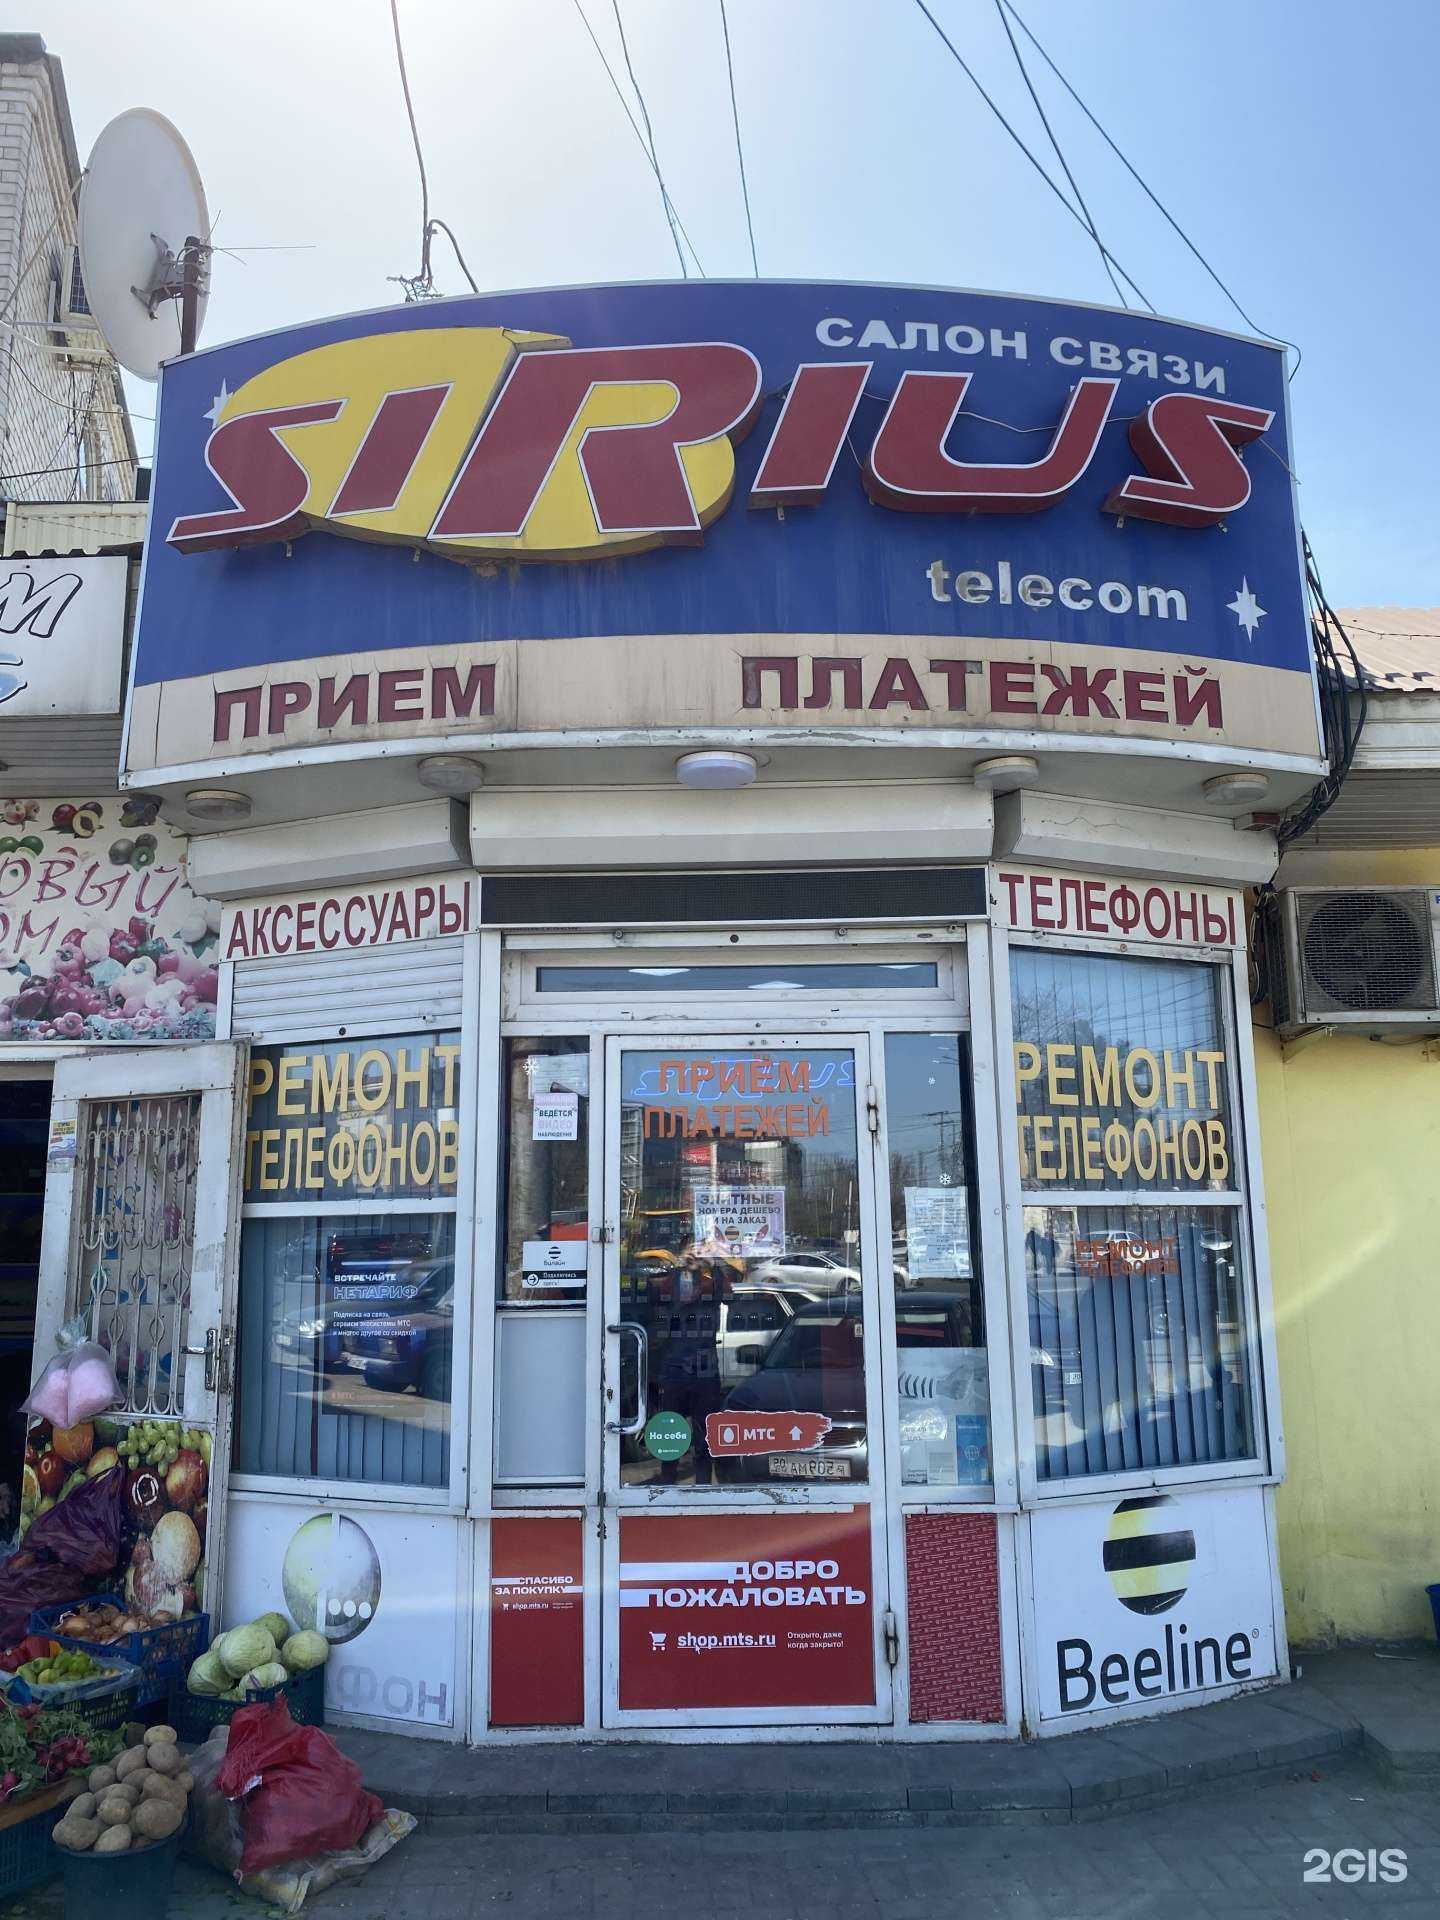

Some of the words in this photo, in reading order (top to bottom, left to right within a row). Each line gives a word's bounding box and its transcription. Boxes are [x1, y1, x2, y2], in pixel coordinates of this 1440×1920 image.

[815, 317, 1028, 359] САЛОН
[1049, 335, 1228, 394] СВЯЗИ
[166, 341, 1276, 542] SIRIUS
[926, 559, 1188, 621] telecom
[213, 663, 497, 742] ПРИЕМ
[742, 656, 1224, 729] ПЛАТЕЖЕЙ
[226, 881, 471, 959] АКСЕССУАРЫ
[999, 873, 1237, 945] ТЕЛЕФОНЫ
[247, 1045, 461, 1118] РЕМОНТ
[1013, 1042, 1225, 1110] РЕМОНТ
[644, 1095, 830, 1138] ПЛАТЕЖЕЙ
[245, 1120, 459, 1190] ТЕЛЕФОНОВ
[1017, 1115, 1229, 1181] ТЕЛЕФОНОВ
[737, 1216, 767, 1224] ЗАКАЗ
[333, 1285, 418, 1300] НЕТАРИФ
[334, 1272, 397, 1283] ВСТРЕЧАЙТЕ
[743, 1428, 775, 1440] МТС
[494, 1587, 511, 1595] ЗА
[512, 1585, 568, 1595] ПОКУПКУ
[520, 1575, 574, 1585] СПАСИБО
[728, 1560, 840, 1584] ДОБРО
[648, 1586, 866, 1608] ПОЖАЛОВАТЬ
[677, 1632, 776, 1649] shop.mts.ru
[787, 1631, 822, 1640] Открыто,
[823, 1631, 843, 1640] даже
[787, 1642, 809, 1650] когда
[810, 1641, 844, 1649] закрыто!
[1057, 1624, 1251, 1712] Beeline
